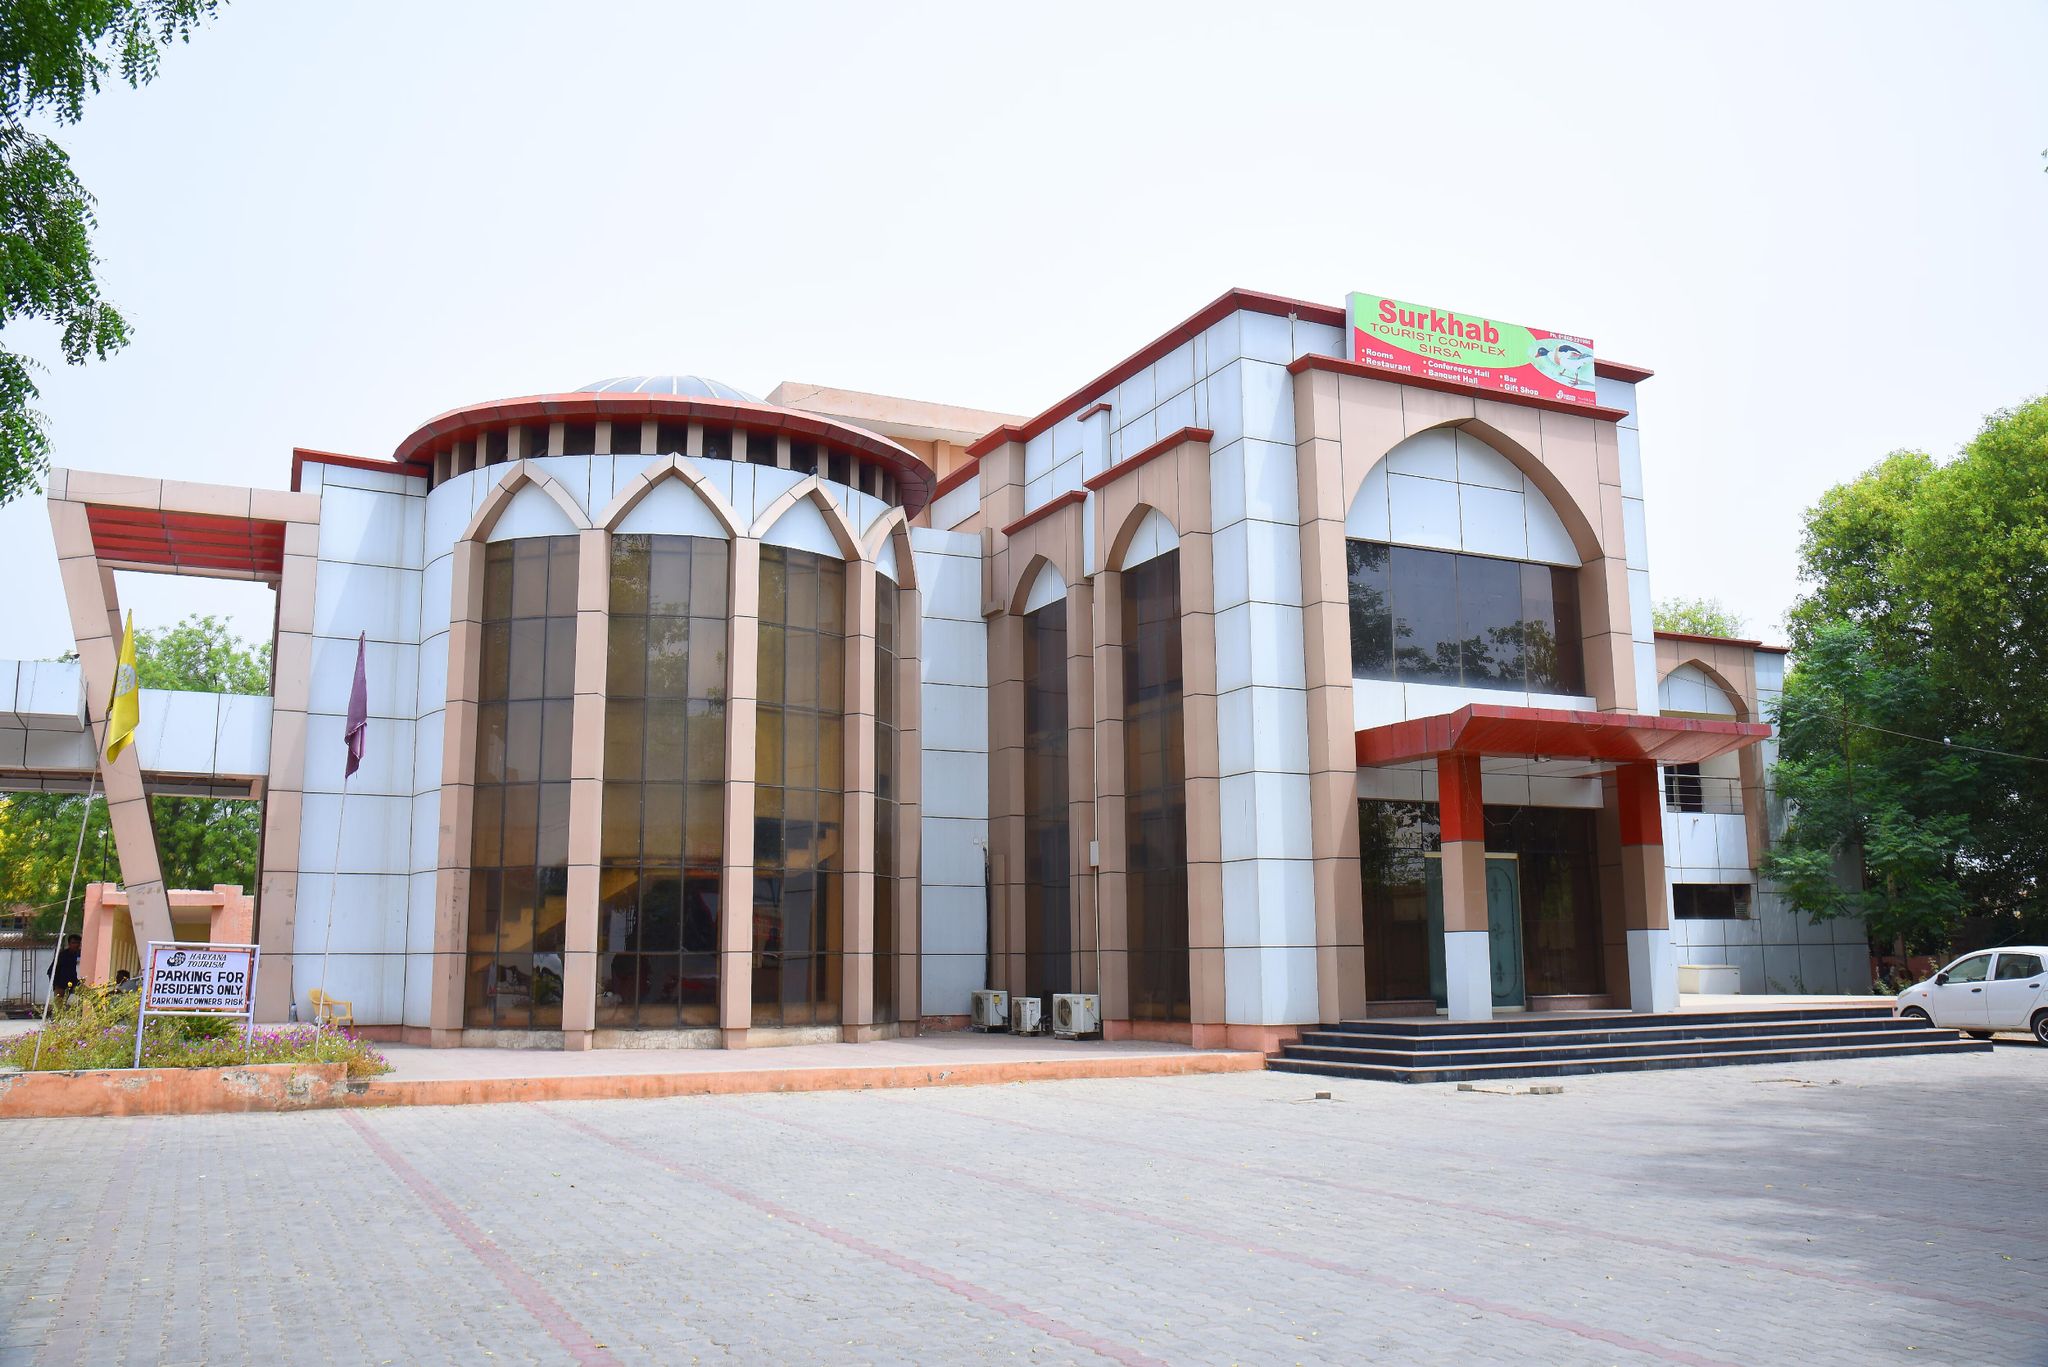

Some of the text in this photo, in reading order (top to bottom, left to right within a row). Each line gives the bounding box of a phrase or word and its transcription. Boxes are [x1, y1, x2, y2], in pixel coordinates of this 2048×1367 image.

[1379, 299, 1499, 345] Surkhab
[1370, 322, 1506, 357] TOURIST COMPLEX
[1366, 348, 1394, 360] Rooms
[1419, 343, 1462, 360] SIRSA
[1366, 357, 1412, 372] Restaurant
[1427, 360, 1490, 378] Conference Hall
[1428, 369, 1478, 384] Banquet Hall
[1503, 374, 1518, 383] Bar
[1504, 383, 1539, 396] Gift Shop
[189, 953, 227, 961] HARYANA
[187, 960, 226, 968] TOURISM
[155, 970, 245, 983] PARKING FOR
[153, 983, 243, 996] RESIDENTS ONLY
[151, 997, 244, 1006] PARKING AT OWNERS RISK
